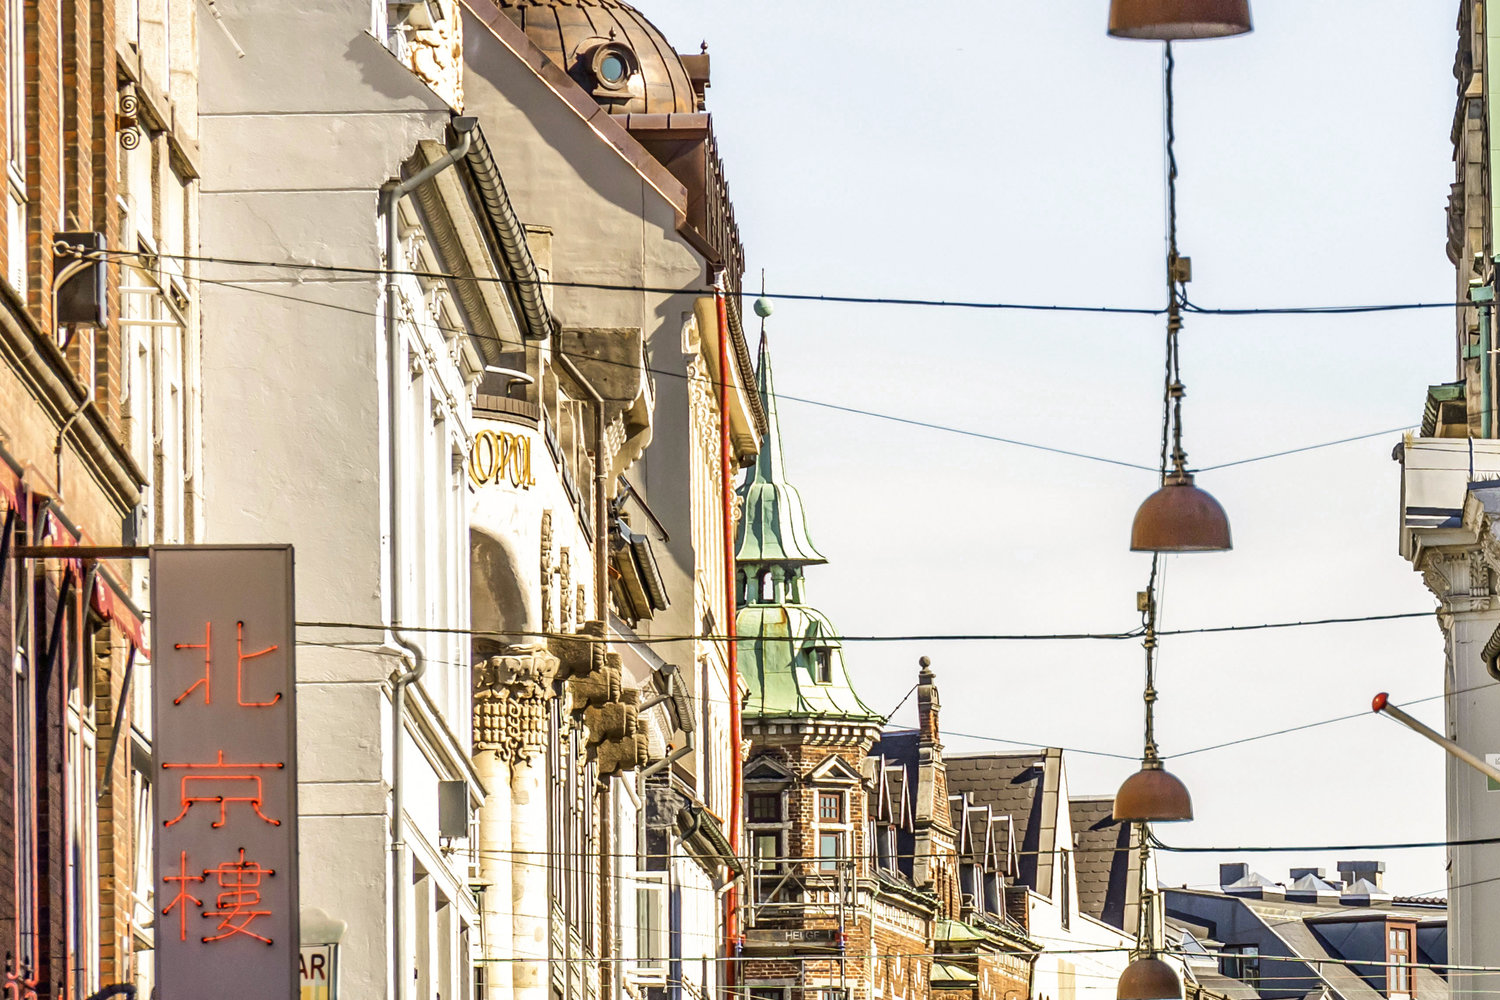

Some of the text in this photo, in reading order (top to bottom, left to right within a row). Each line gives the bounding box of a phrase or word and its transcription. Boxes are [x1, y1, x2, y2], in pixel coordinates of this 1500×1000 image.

[468, 430, 536, 488] OPOL
[163, 620, 284, 944] 北京樓
[299, 952, 325, 980] AR
